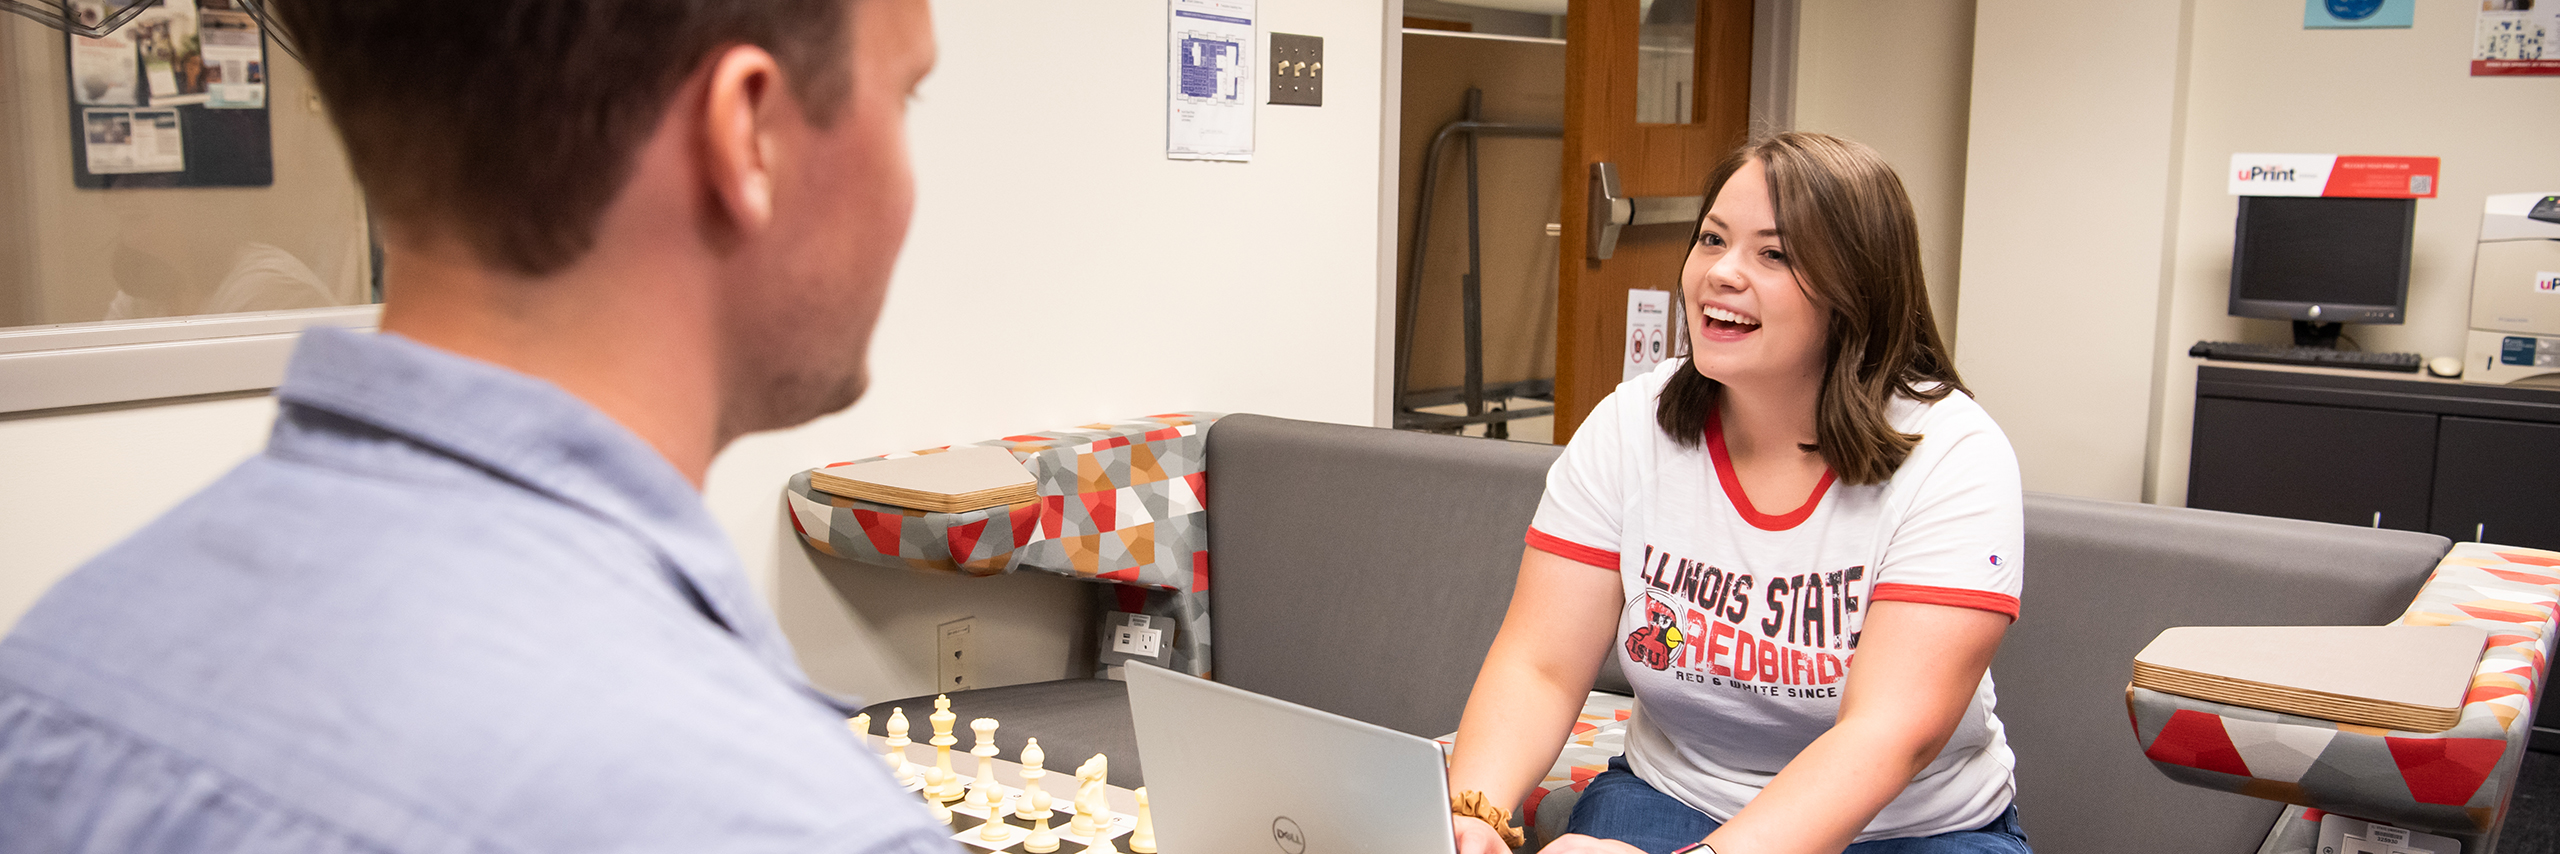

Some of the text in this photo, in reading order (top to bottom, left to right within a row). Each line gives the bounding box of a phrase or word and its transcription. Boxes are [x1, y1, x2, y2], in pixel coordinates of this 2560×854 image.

[2238, 166, 2296, 182] uPrint
[1761, 565, 1864, 650] STATE
[1631, 640, 1661, 666] ISU
[1676, 607, 1855, 686] REDBIRD
[1676, 670, 1838, 699] RED & WHITE SINCE
[1276, 828, 1303, 846] DELL
